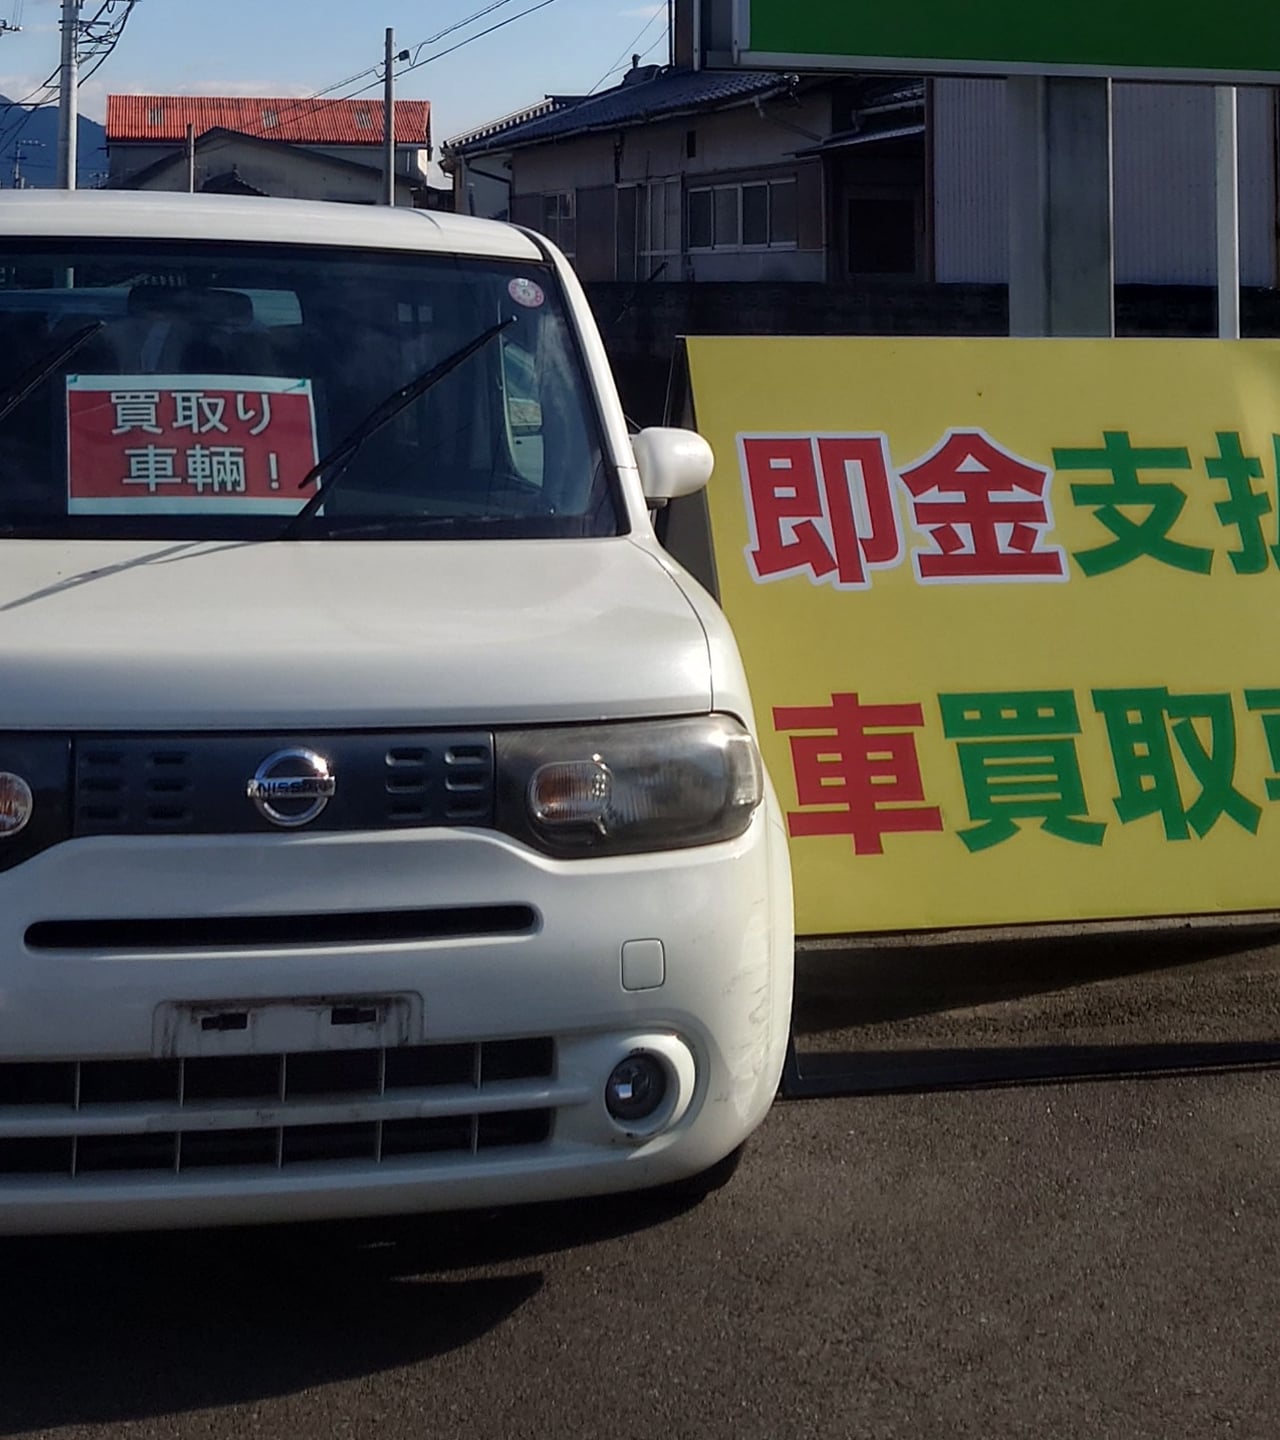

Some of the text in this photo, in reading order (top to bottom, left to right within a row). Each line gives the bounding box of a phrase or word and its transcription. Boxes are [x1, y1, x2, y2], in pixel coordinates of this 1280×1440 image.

[111, 391, 271, 436] 買取り
[258, 781, 329, 794] NISS
